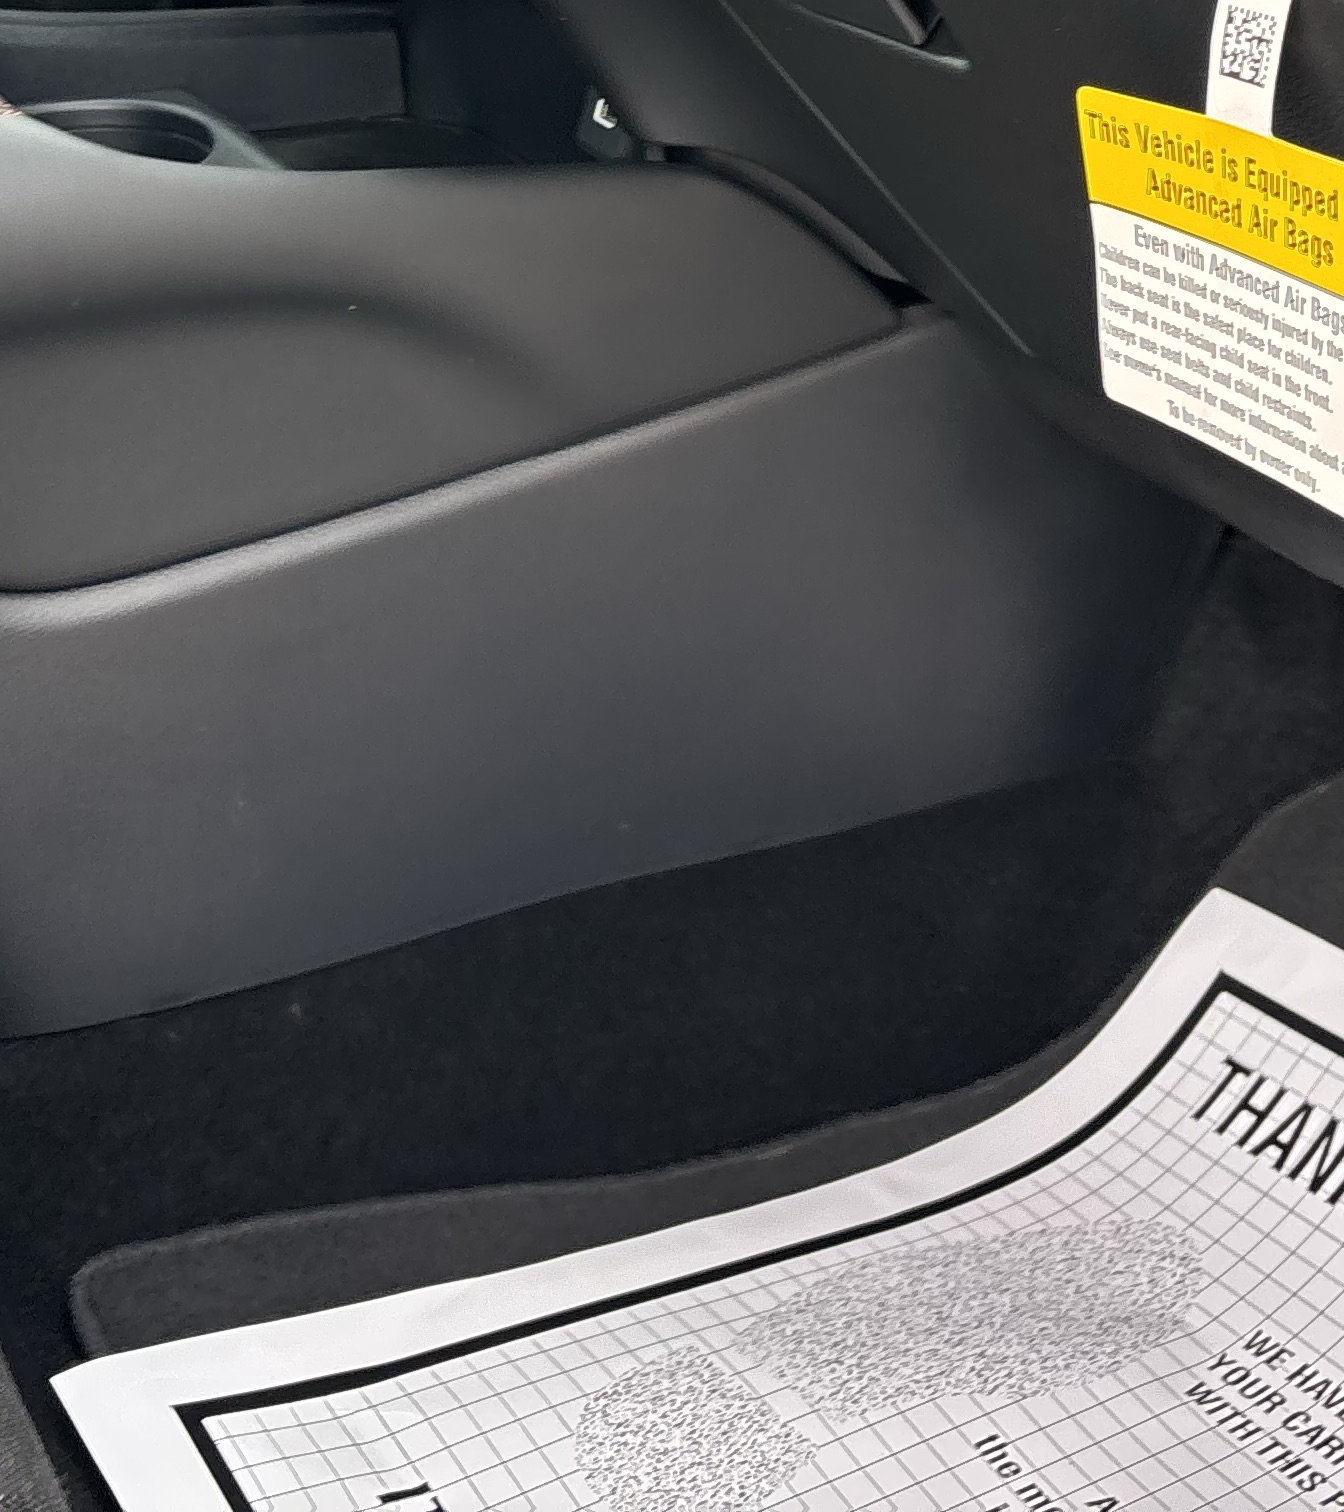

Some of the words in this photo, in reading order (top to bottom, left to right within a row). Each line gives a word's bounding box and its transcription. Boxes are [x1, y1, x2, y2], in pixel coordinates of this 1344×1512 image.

[1084, 109, 1131, 149] This
[1134, 123, 1215, 174] Vehicle
[1220, 148, 1239, 182] is
[1245, 157, 1339, 222] Equipped
[1146, 168, 1243, 229] Advanced
[1248, 204, 1279, 242] Air
[1284, 217, 1334, 268] Bags
[1134, 224, 1169, 257] Even
[1173, 243, 1205, 271] with
[1209, 253, 1280, 304] Advanced
[1284, 286, 1307, 315] Air
[1207, 1352, 1289, 1415] YOUR
[1241, 1328, 1294, 1371] WE
[1184, 1380, 1258, 1442] WITH
[1256, 1440, 1328, 1496] THIS
